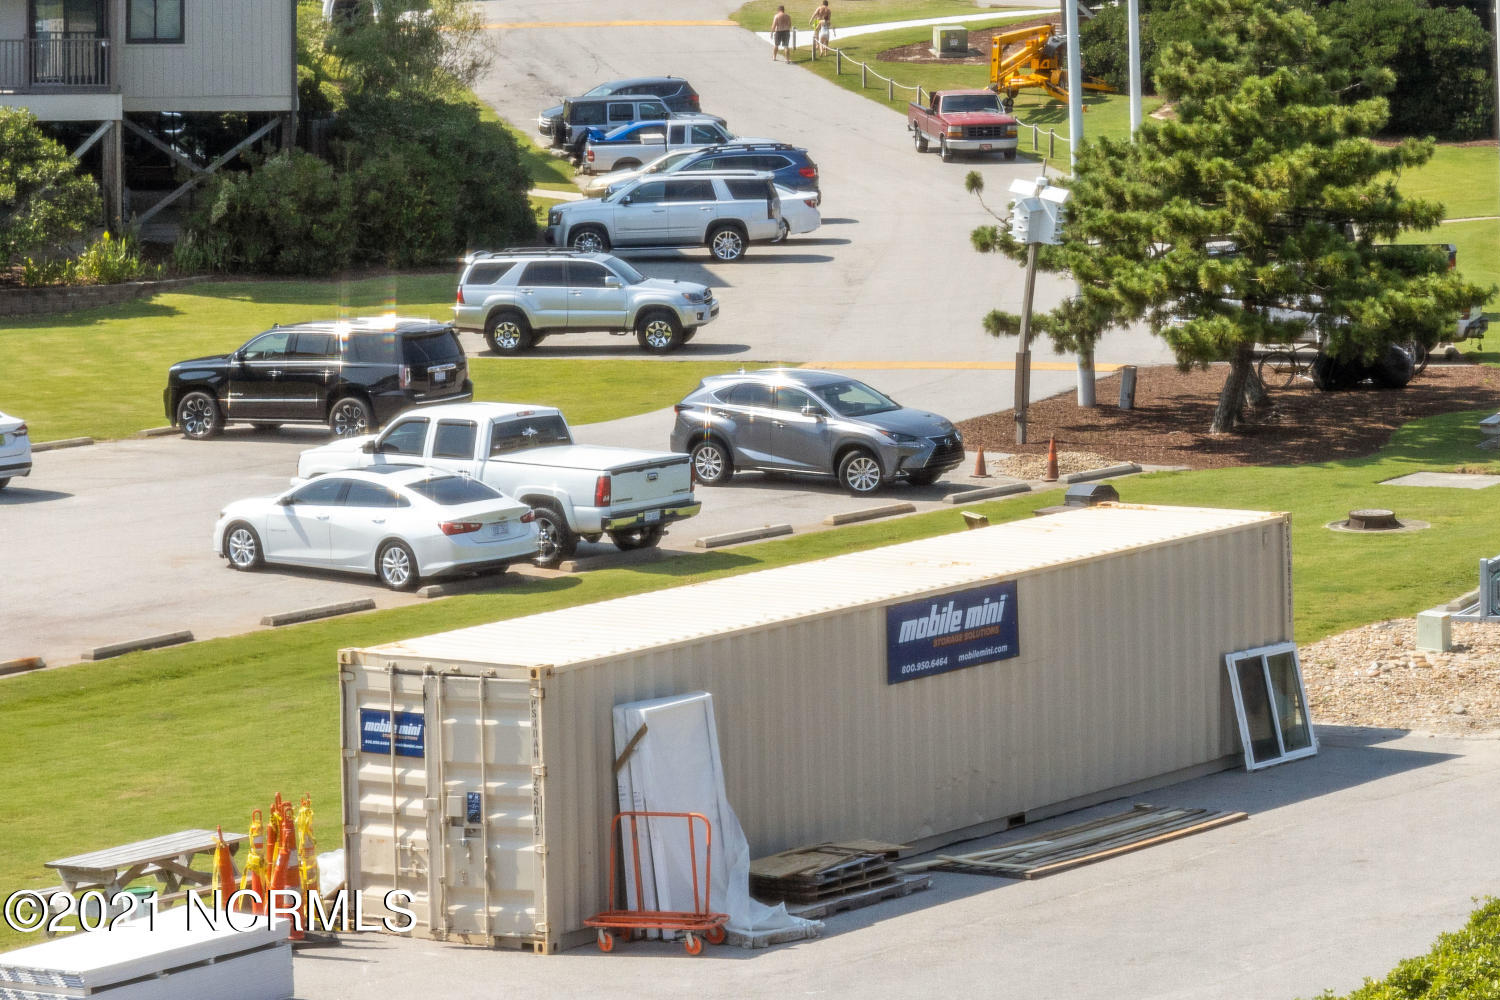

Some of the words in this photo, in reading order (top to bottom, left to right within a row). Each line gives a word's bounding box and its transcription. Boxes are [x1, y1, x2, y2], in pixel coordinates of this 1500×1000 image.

[898, 601, 962, 643] mobile
[965, 594, 1006, 629] mini
[964, 625, 1001, 641] SOLUTIONS
[958, 644, 1008, 662] mobilemini.com
[901, 657, 948, 674] 800.950.6464
[399, 723, 422, 736] mini
